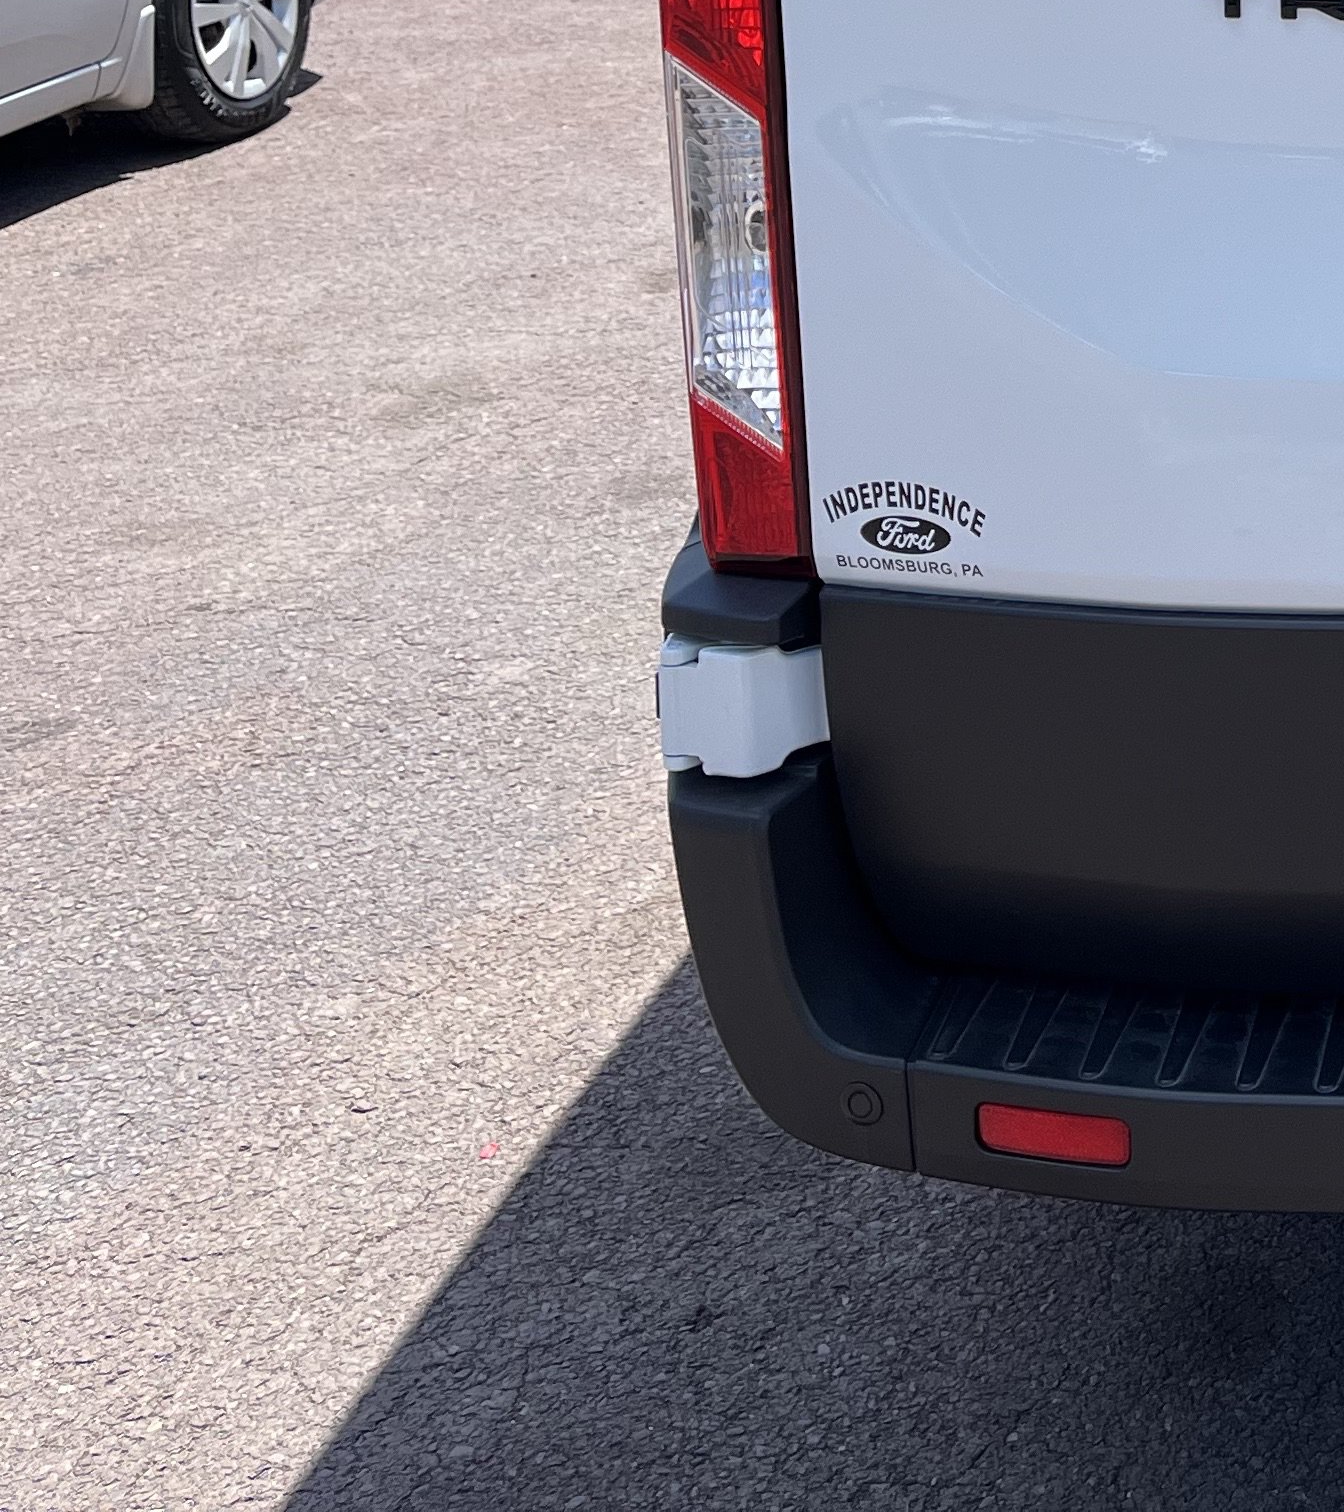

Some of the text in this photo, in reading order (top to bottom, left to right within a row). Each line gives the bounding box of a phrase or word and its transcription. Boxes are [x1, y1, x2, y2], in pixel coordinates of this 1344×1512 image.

[822, 481, 987, 538] INDEPENDENCE
[876, 517, 936, 552] Ford
[836, 554, 984, 578] BLOOMSBURG, PA
